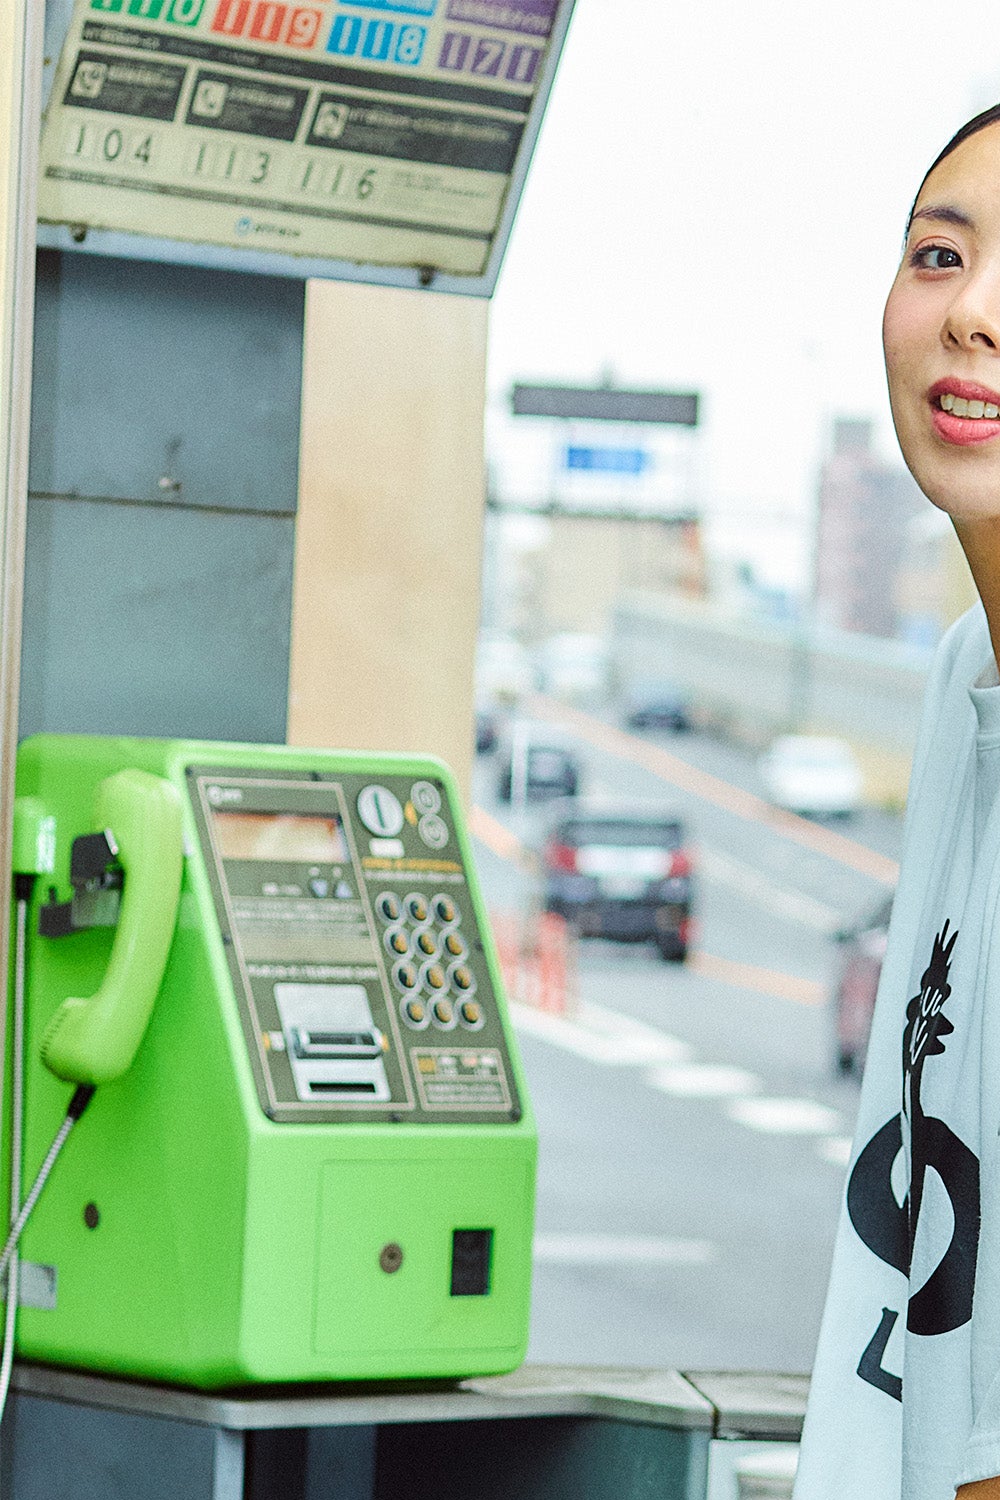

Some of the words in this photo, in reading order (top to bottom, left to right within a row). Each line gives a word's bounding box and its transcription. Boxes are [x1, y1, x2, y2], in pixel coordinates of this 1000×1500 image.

[102, 0, 200, 22] 10
[223, 0, 319, 44] 119
[338, 18, 422, 62] 118
[447, 36, 533, 80] 171
[76, 124, 151, 164] 104
[196, 143, 270, 184] 113
[302, 160, 376, 200] 116
